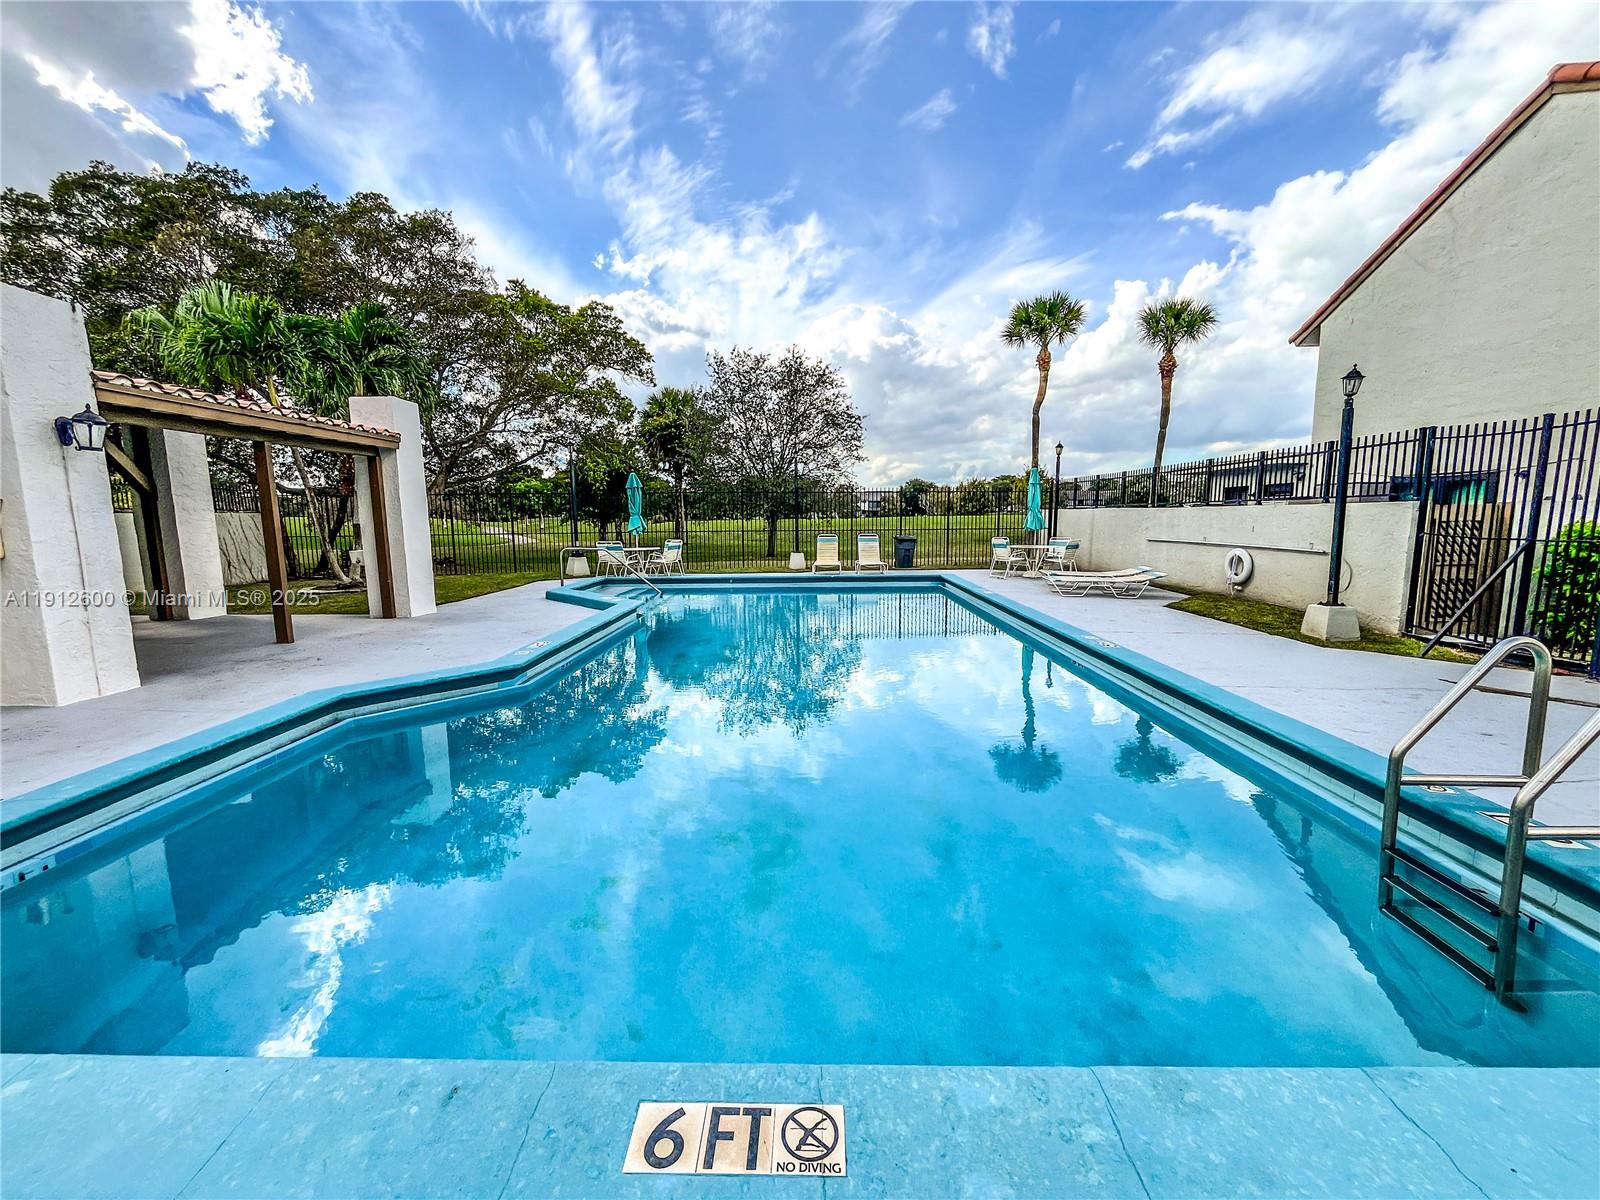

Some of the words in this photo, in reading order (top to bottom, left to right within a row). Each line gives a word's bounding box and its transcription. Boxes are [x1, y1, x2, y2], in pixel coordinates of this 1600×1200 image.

[643, 1107, 686, 1169] 6
[702, 1107, 772, 1171] FT
[776, 1161, 796, 1172] NO
[799, 1162, 842, 1174] DIVING
